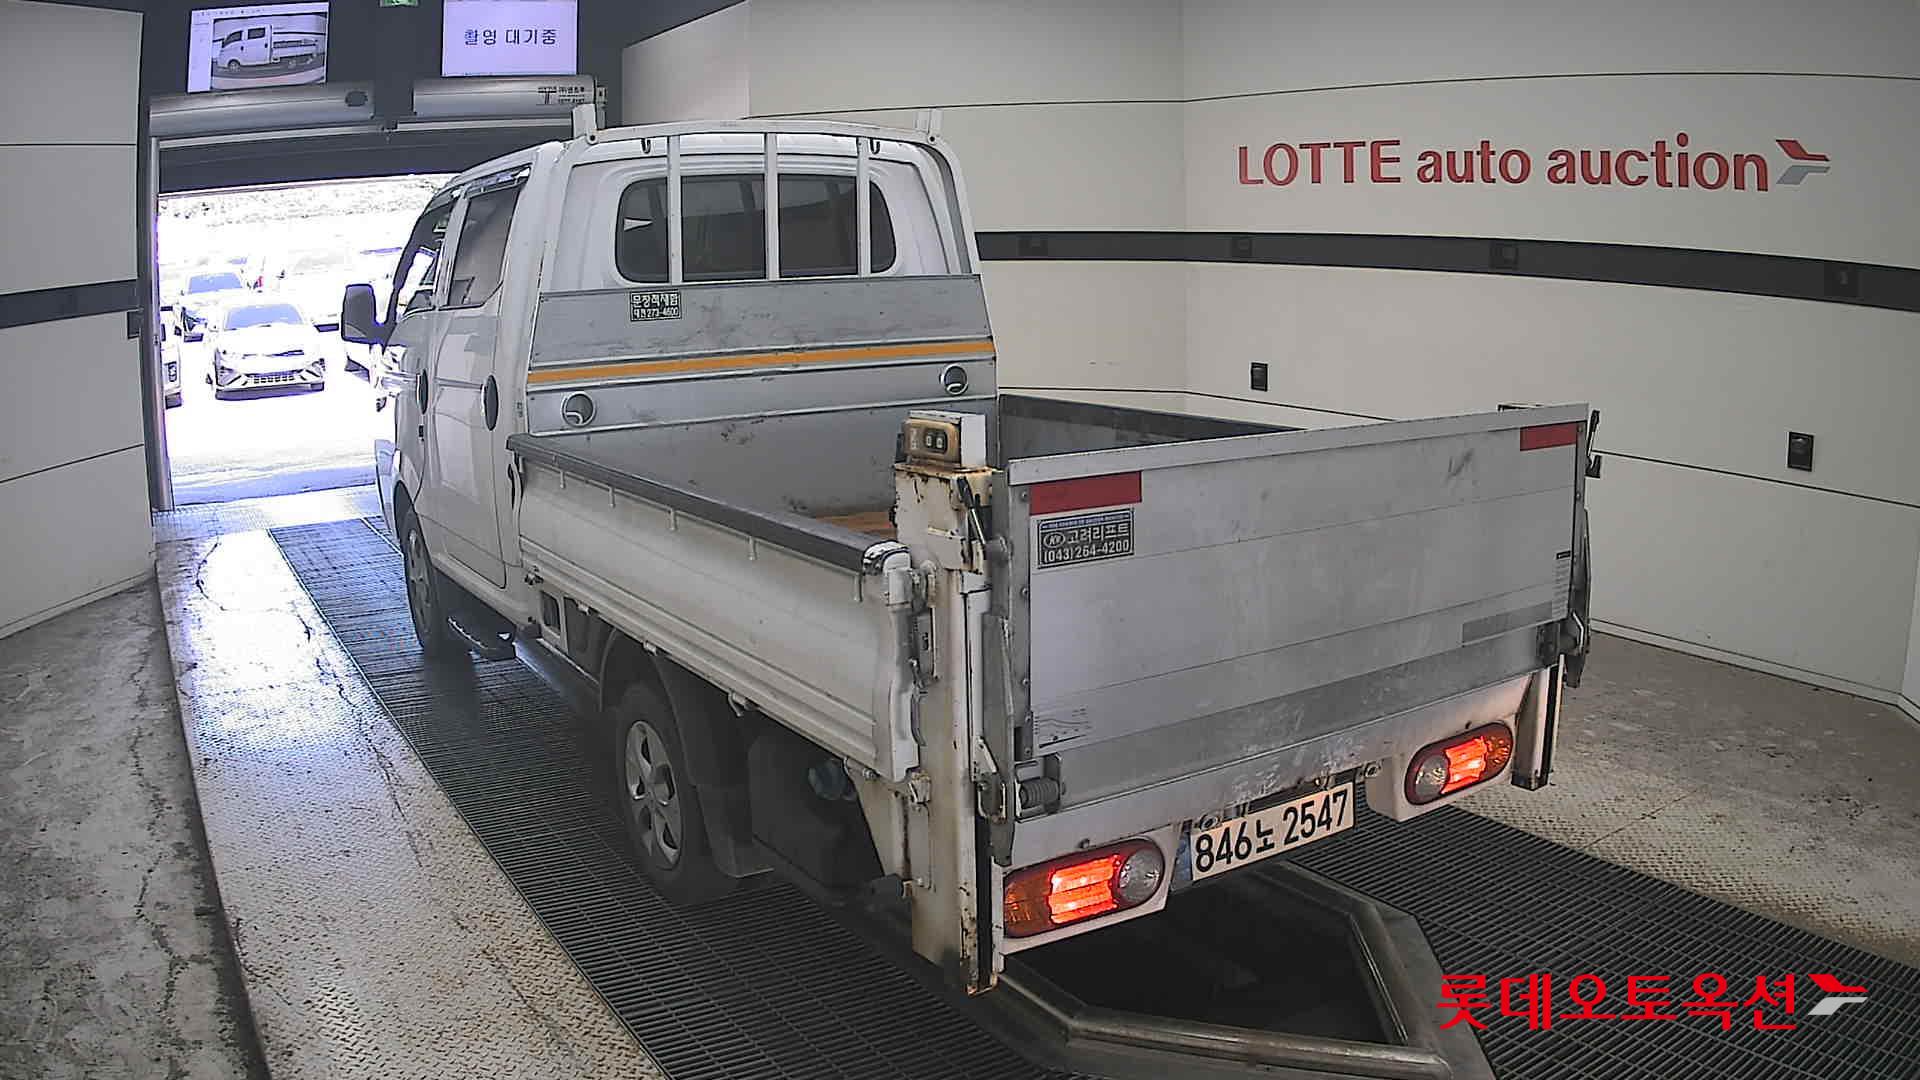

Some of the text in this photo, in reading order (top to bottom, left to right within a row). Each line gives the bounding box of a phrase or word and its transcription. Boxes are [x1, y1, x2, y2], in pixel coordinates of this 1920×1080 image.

[505, 29, 556, 45] 대기중
[1238, 132, 1769, 192] LOTTE auto auction
[1067, 523, 1129, 544] 고려리프트
[1044, 539, 1130, 564] (043)264-4200
[1195, 788, 1348, 873] 846노 2547
